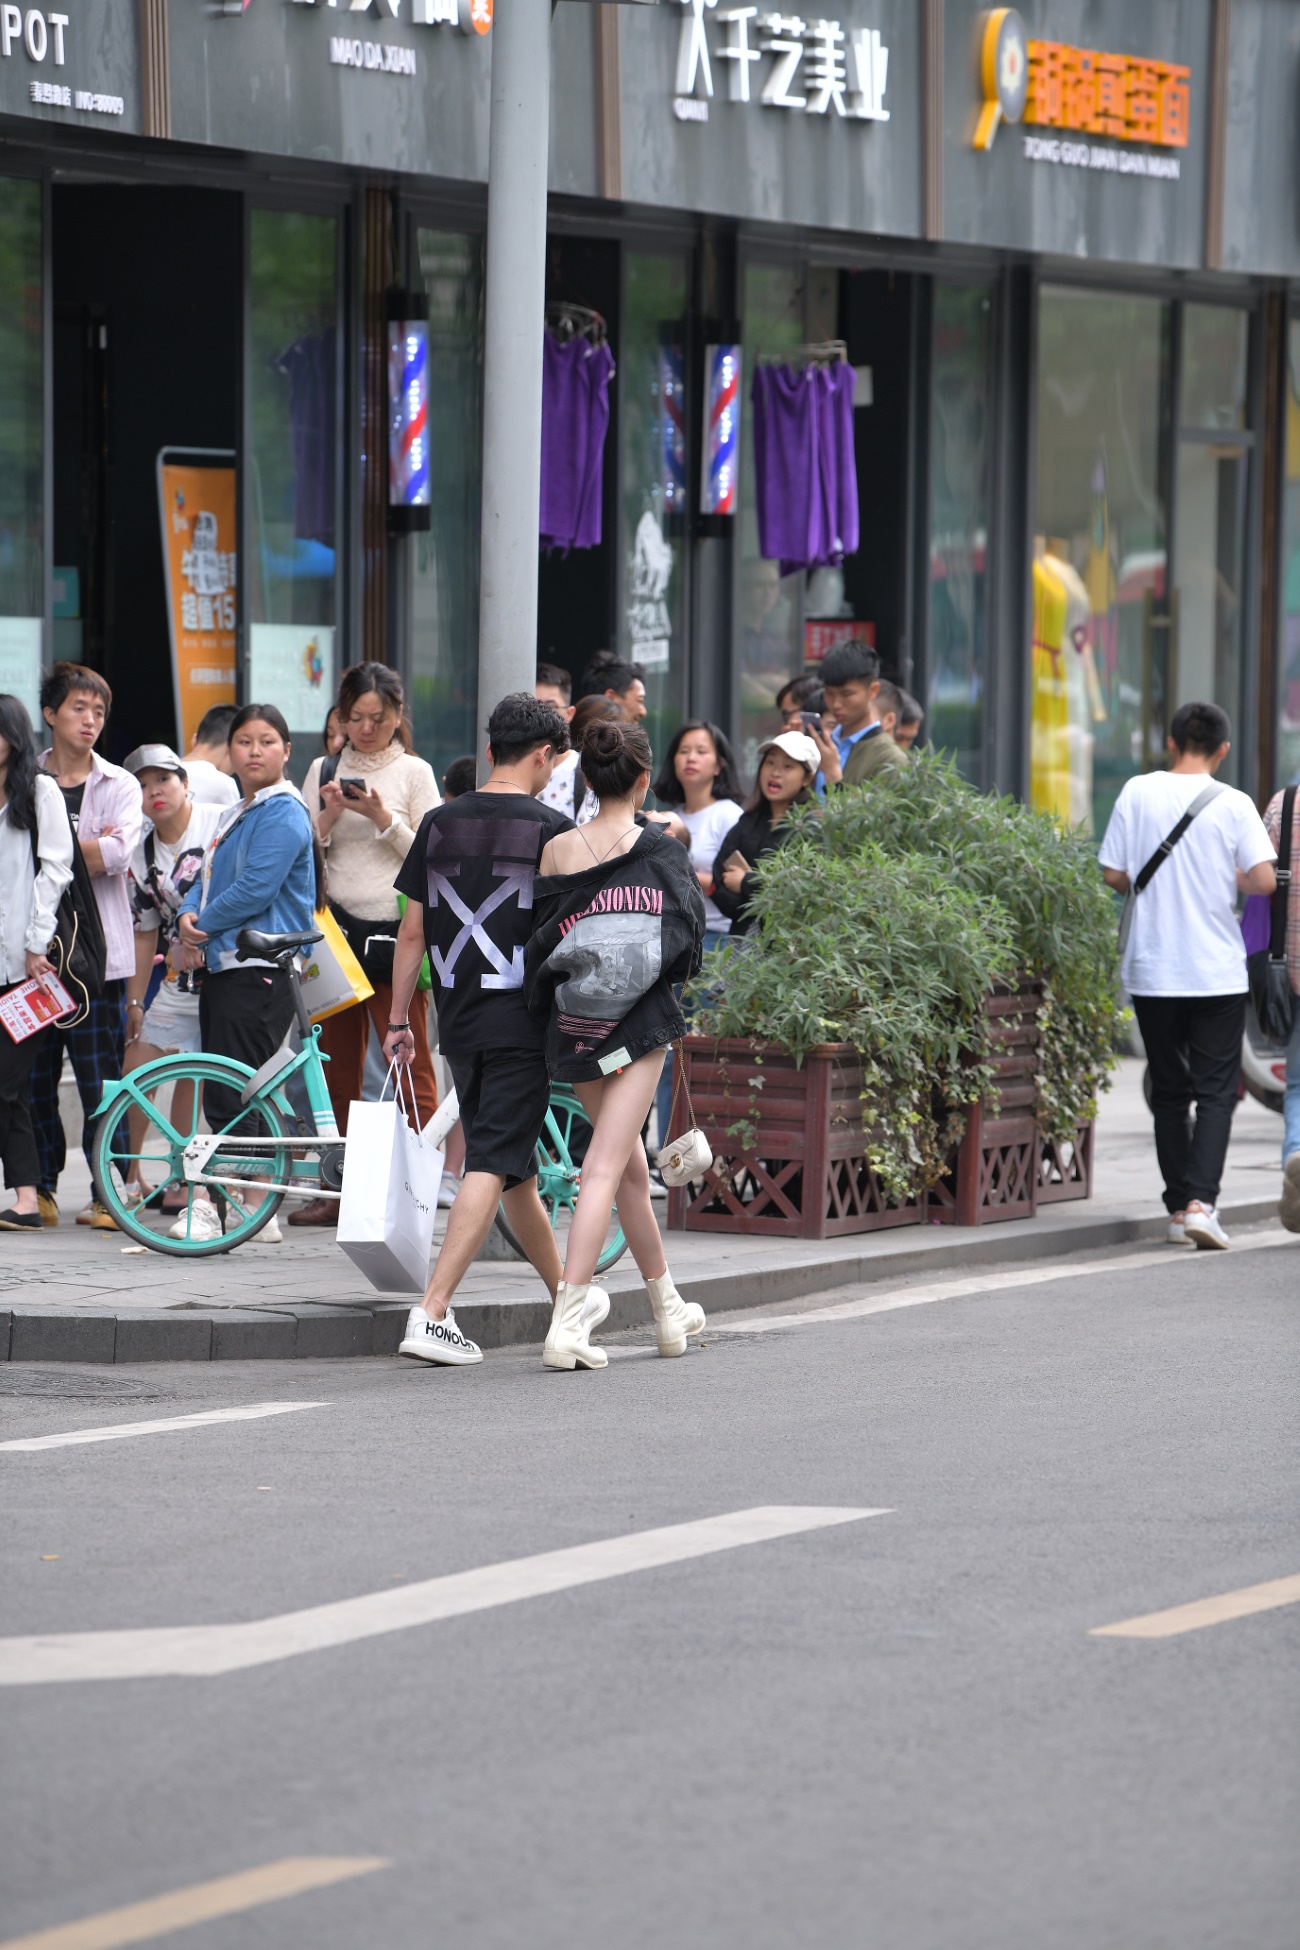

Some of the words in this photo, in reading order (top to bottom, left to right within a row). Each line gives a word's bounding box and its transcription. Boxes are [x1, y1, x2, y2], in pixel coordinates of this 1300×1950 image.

[1, 4, 69, 65] POT
[330, 37, 364, 68] MAO
[365, 41, 384, 70] DA
[384, 44, 416, 75] XIAN
[1025, 136, 1060, 163] TONG
